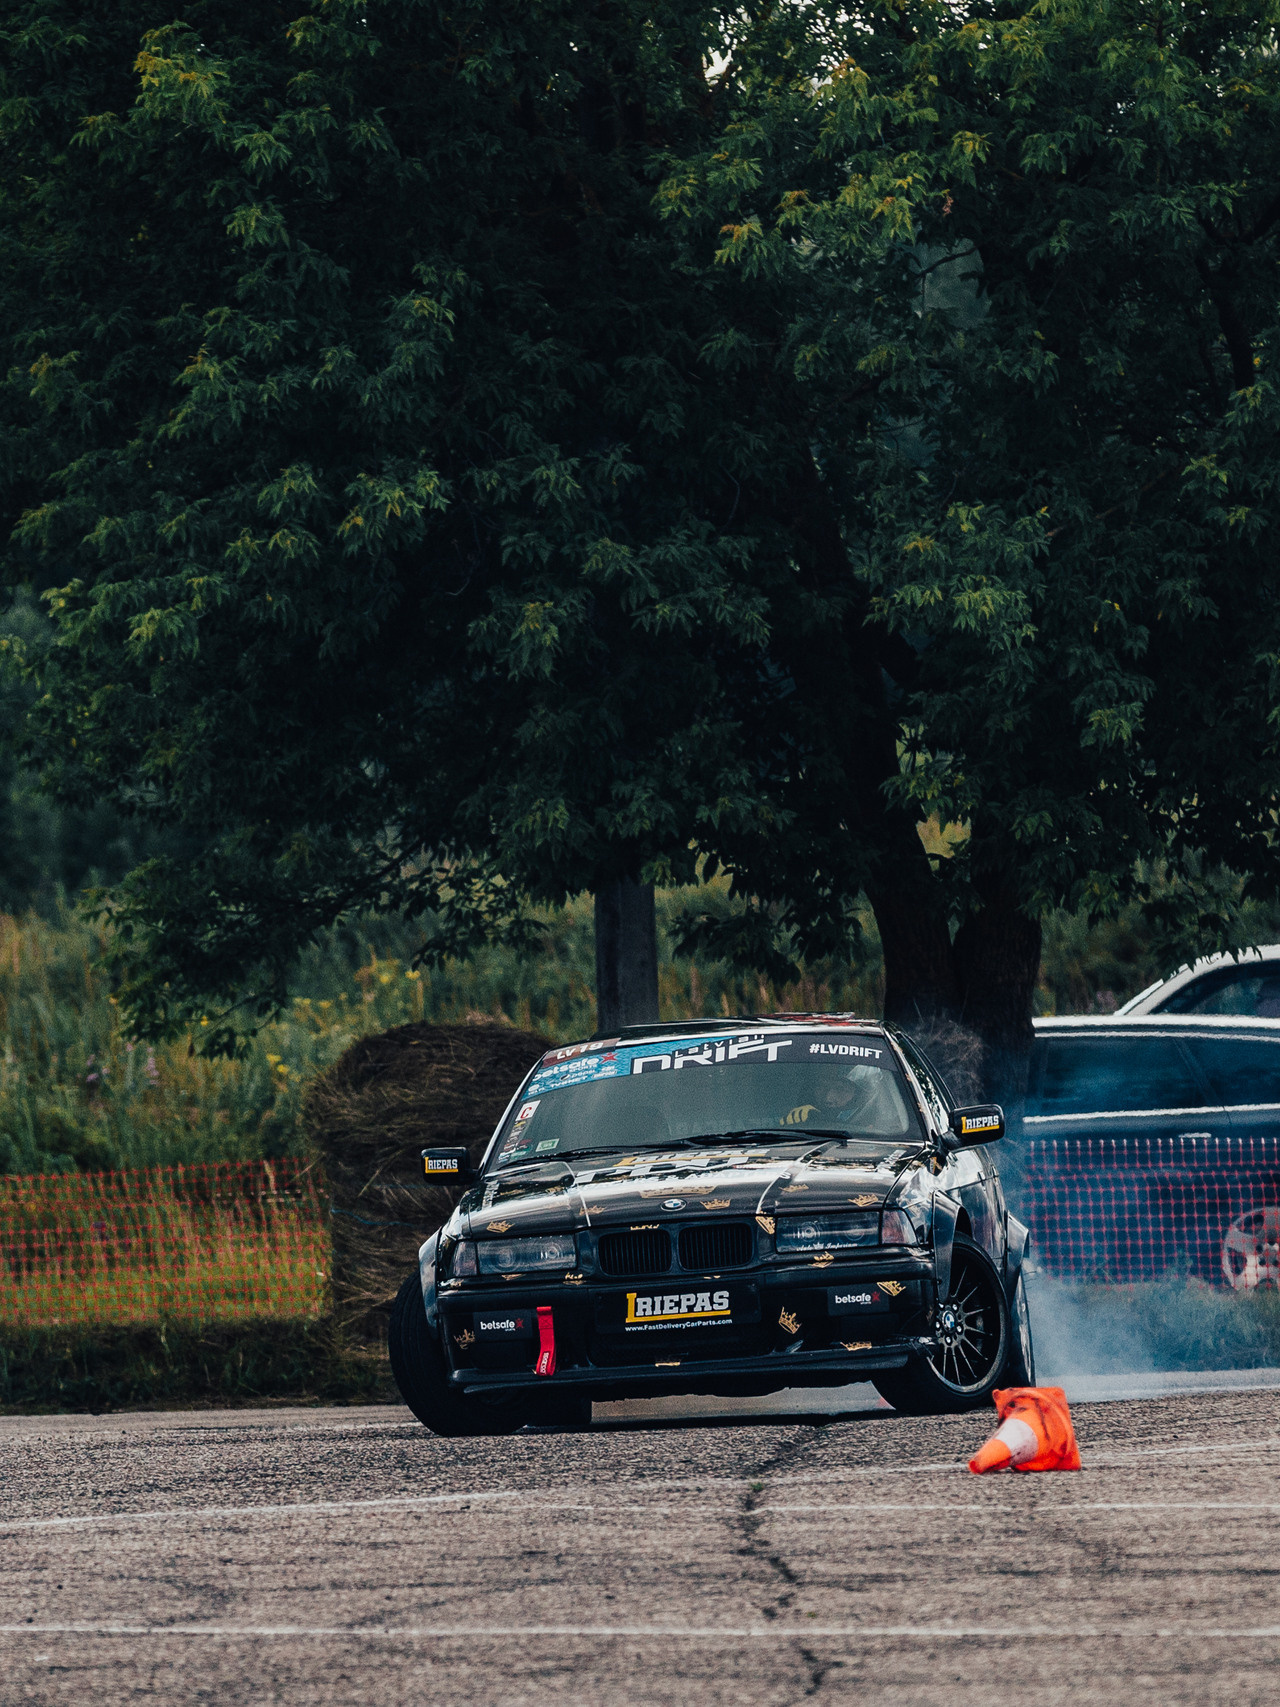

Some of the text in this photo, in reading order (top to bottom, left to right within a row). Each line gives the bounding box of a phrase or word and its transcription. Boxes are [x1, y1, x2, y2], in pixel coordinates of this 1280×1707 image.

[632, 1039, 793, 1075] DRIFT
[809, 1043, 883, 1060] #LVDRIFT
[520, 1106, 533, 1119] C
[834, 1292, 872, 1304] betsafe
[480, 1319, 516, 1330] betsafe
[624, 1318, 733, 1332] www.FastDeliveryCarParts.com
